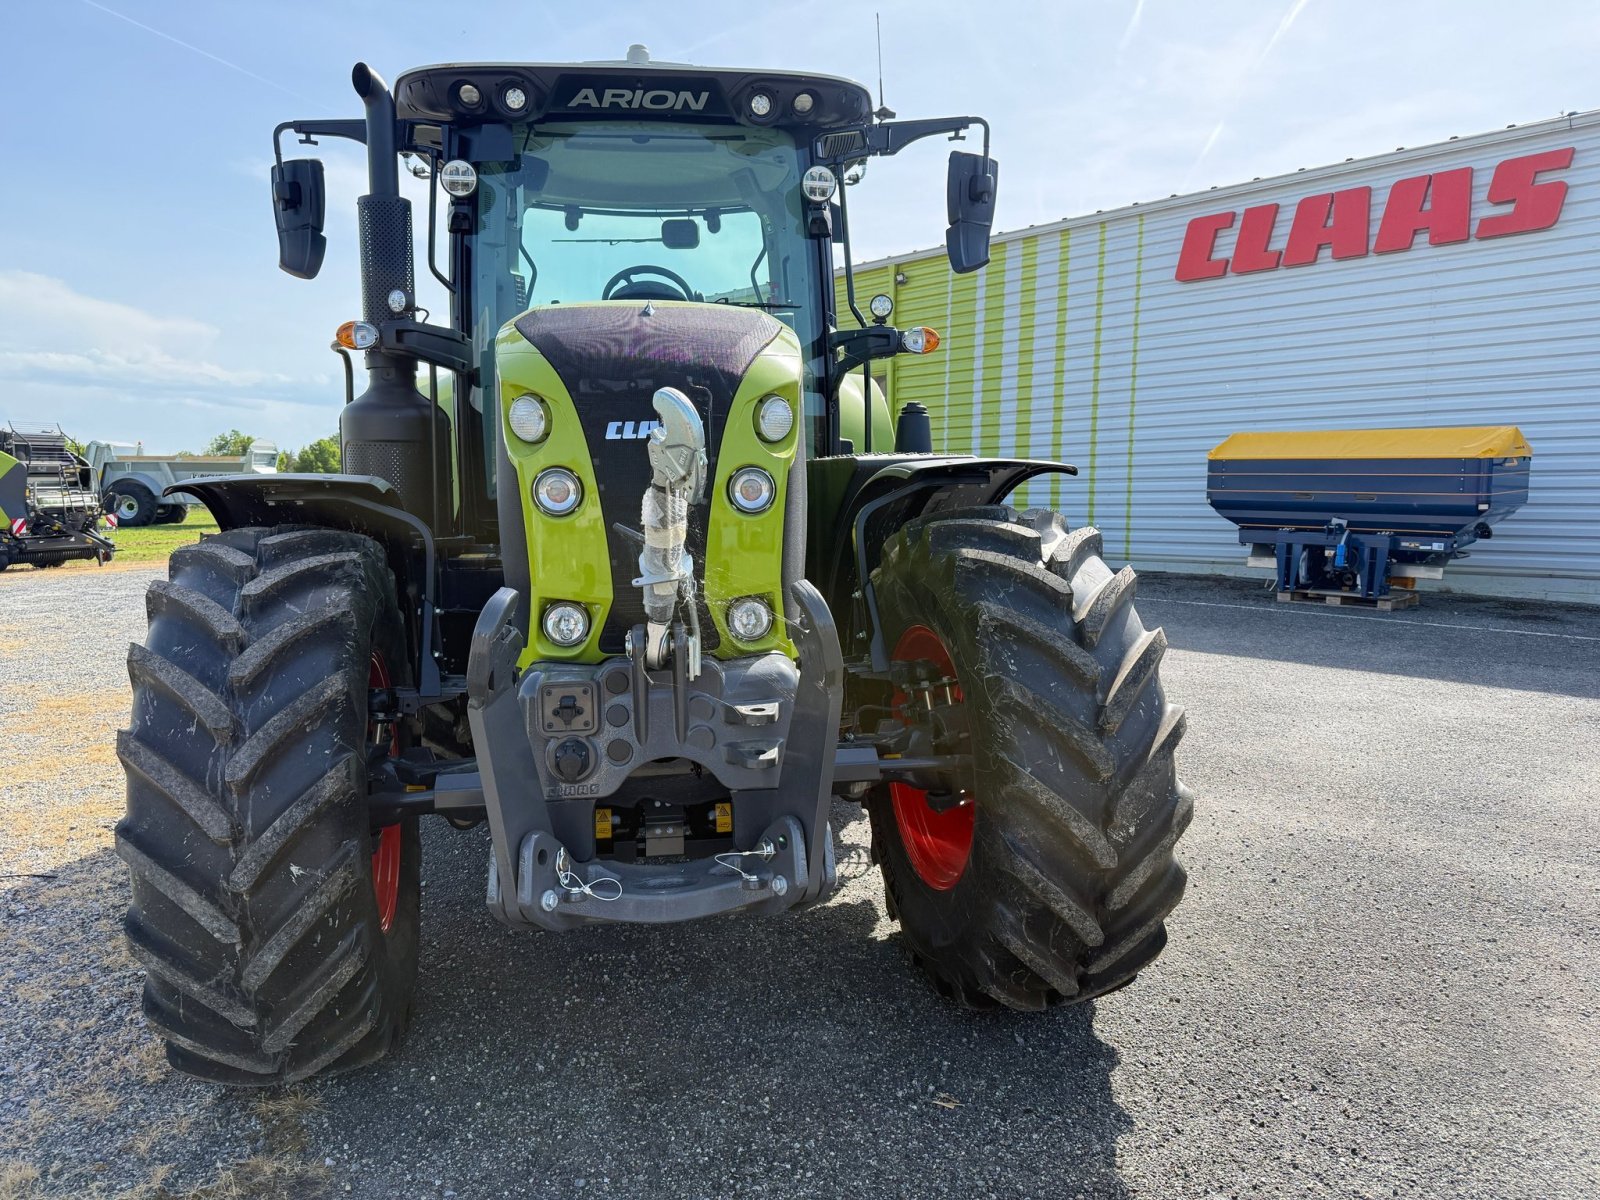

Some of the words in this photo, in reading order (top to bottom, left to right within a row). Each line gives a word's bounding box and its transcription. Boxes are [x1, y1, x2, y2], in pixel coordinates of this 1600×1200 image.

[567, 88, 710, 110] ARION
[1175, 147, 1576, 282] CLAAS
[605, 420, 703, 440] CLA
